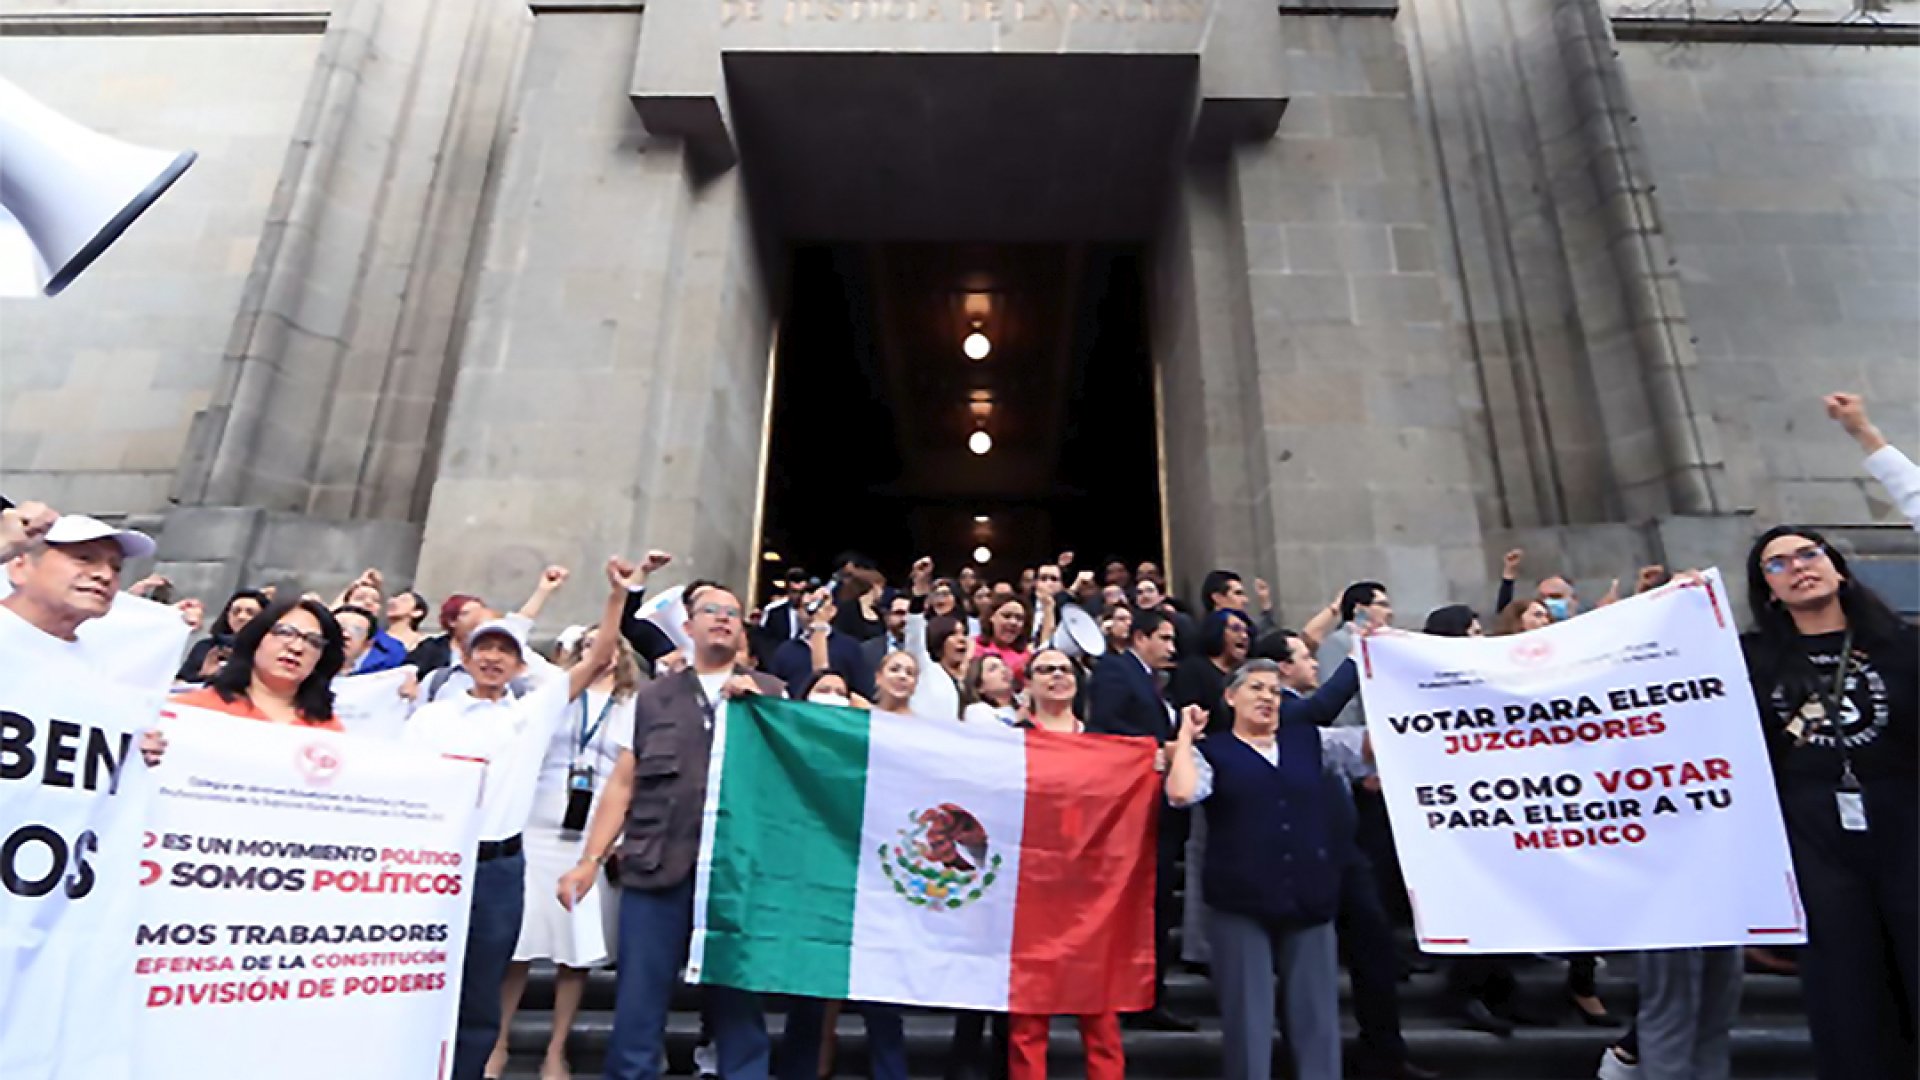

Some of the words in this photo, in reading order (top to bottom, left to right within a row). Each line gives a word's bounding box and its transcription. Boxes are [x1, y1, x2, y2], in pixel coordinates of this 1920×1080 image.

[1388, 707, 1496, 735] VOTAR
[1503, 695, 1602, 725] PARA
[1607, 677, 1725, 711] ELEGIR
[0, 710, 133, 795] BEN
[1444, 712, 1667, 755] JUZGADORES
[1415, 784, 1458, 806] ES
[1469, 773, 1582, 803] COMO
[1594, 757, 1732, 794] VOTAR
[1427, 807, 1515, 829] PARA
[1524, 798, 1642, 824] ELEGIR
[1653, 795, 1678, 815] A
[1685, 788, 1732, 810] TU
[162, 832, 192, 851] ES
[197, 836, 232, 854] UN
[236, 840, 377, 862] MOVIMIENTO
[1513, 822, 1646, 850] MÉDICO
[0, 824, 98, 899] OS
[170, 861, 306, 891] SOMOS
[312, 864, 462, 896] POLÍTICOS
[136, 923, 217, 945] MOS
[226, 924, 448, 944] TRABAJADORES
[135, 956, 234, 974] EFENSA
[241, 955, 272, 970] DE
[278, 955, 306, 969] LA
[146, 975, 289, 1007] DIVISIÓN
[298, 978, 335, 999] DE
[343, 972, 446, 995] PODERES
